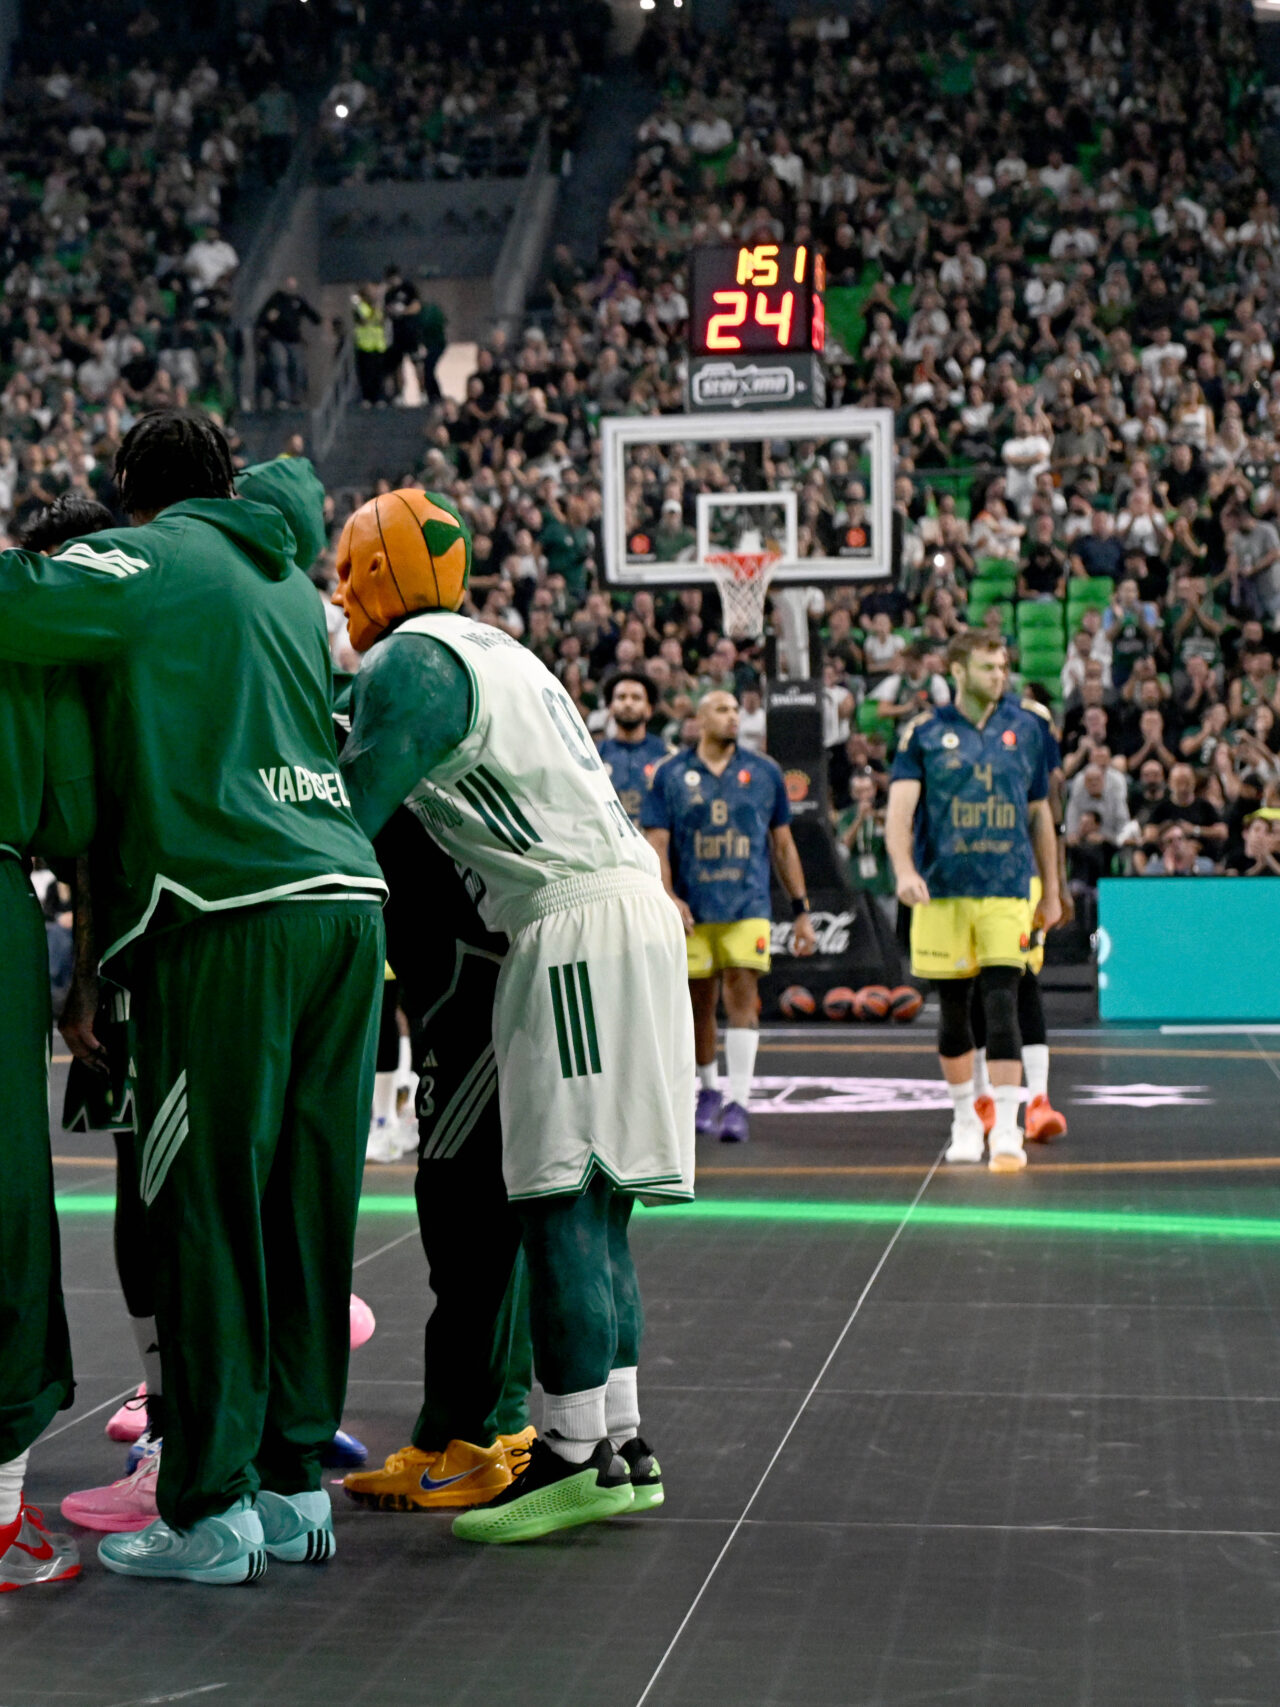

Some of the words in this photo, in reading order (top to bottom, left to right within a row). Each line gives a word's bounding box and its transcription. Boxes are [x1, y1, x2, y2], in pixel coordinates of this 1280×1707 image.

[705, 290, 794, 350] 24
[974, 763, 992, 791] 4
[712, 799, 728, 825] 8
[952, 795, 1016, 828] tarfin
[694, 829, 750, 859] tarfin
